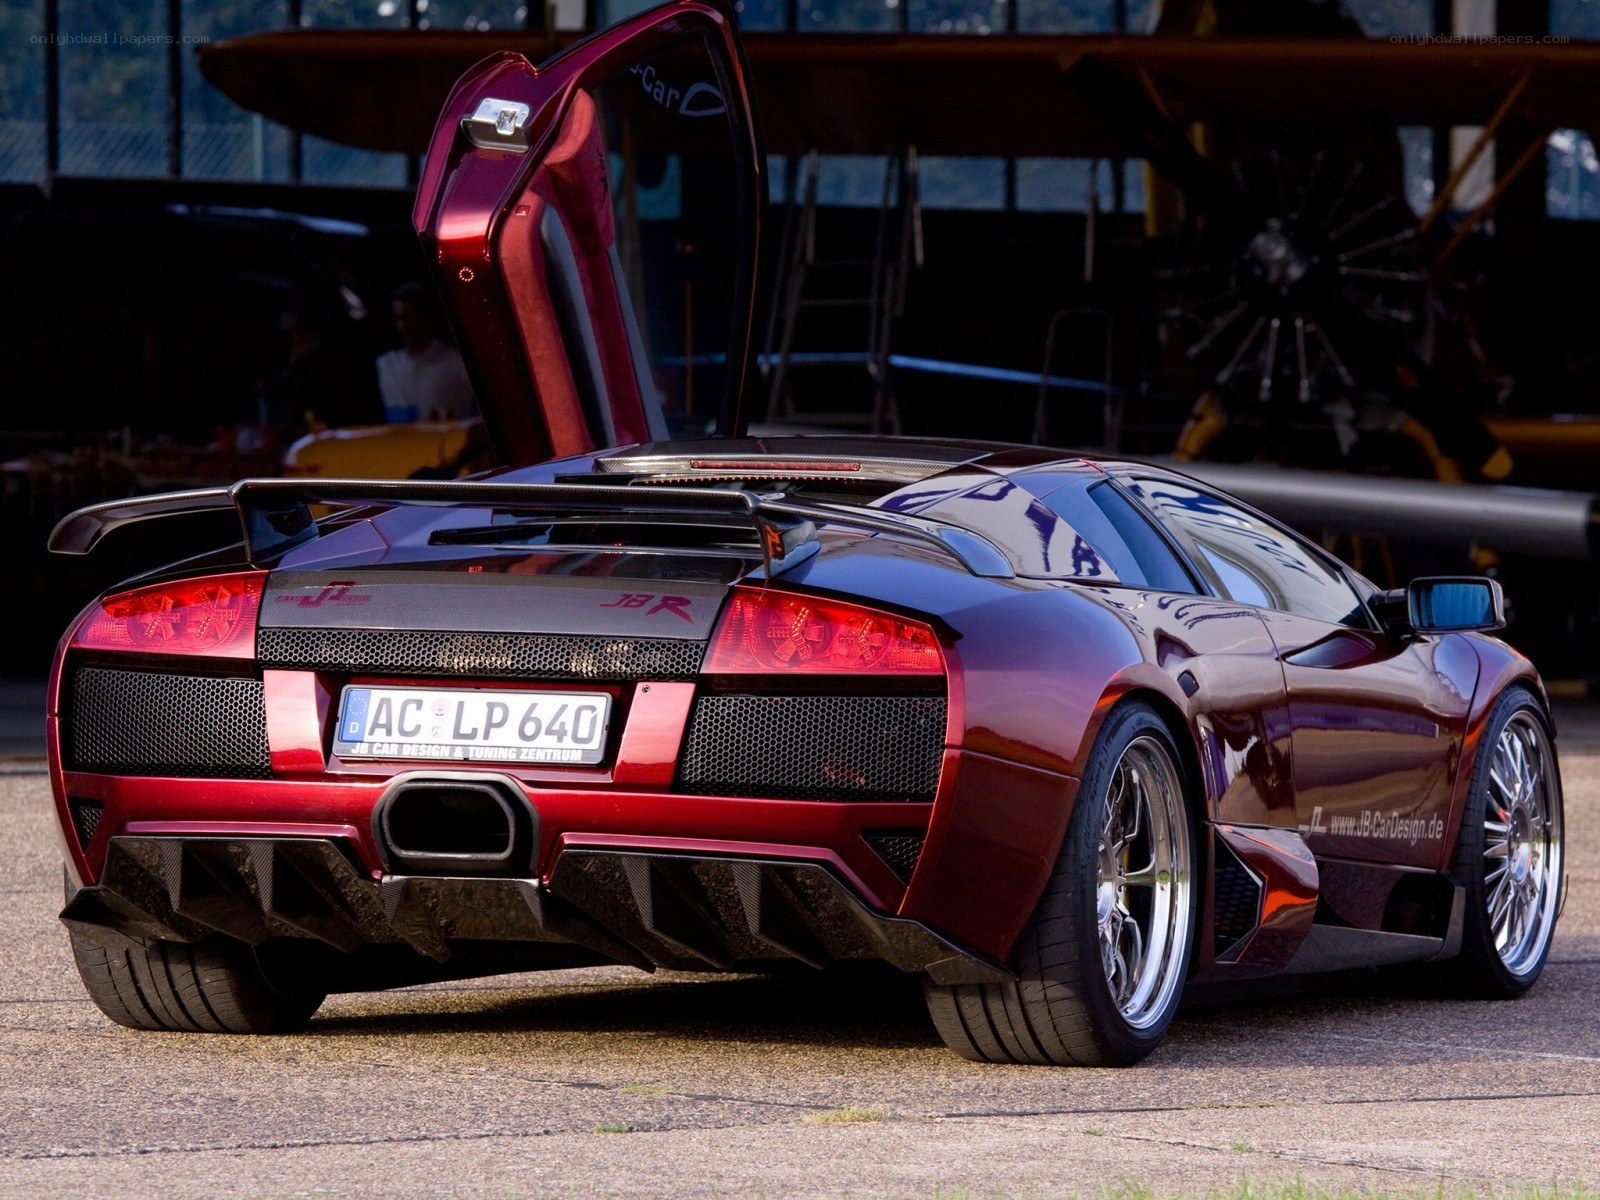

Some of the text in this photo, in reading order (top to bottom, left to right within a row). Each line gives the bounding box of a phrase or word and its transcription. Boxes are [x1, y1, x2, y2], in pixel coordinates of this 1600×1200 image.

[349, 721, 360, 734] D
[368, 697, 598, 745] AC LP 640
[351, 743, 583, 762] JB CAR DESIGN & TUNING ZENTRUM
[1331, 810, 1444, 846] www.JB-CarDesign.de
